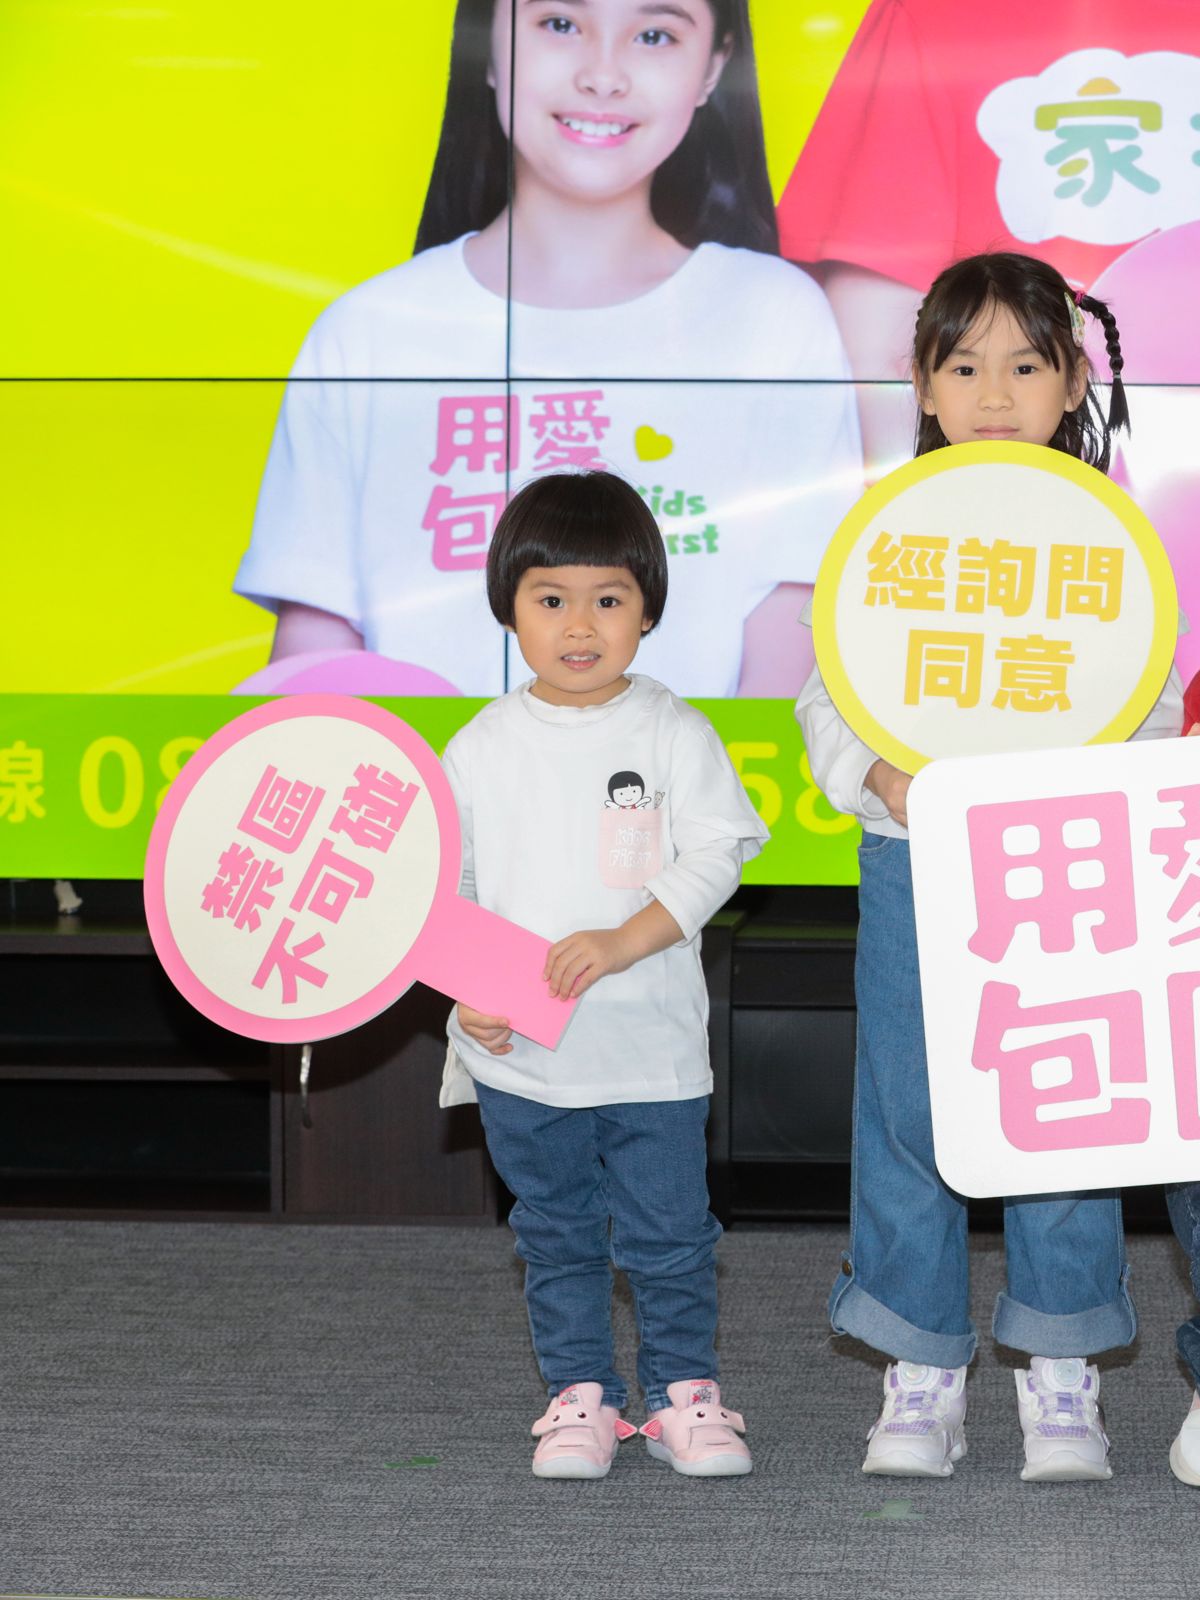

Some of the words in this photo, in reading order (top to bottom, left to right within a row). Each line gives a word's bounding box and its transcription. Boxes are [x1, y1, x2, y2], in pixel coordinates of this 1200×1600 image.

[428, 390, 611, 476] 用愛
[637, 485, 707, 517] ids
[665, 524, 719, 555] rst
[864, 531, 1125, 622] 經詢問
[903, 628, 1076, 713] 同意
[200, 764, 327, 934] 禁區
[251, 763, 421, 1004] 不可碰
